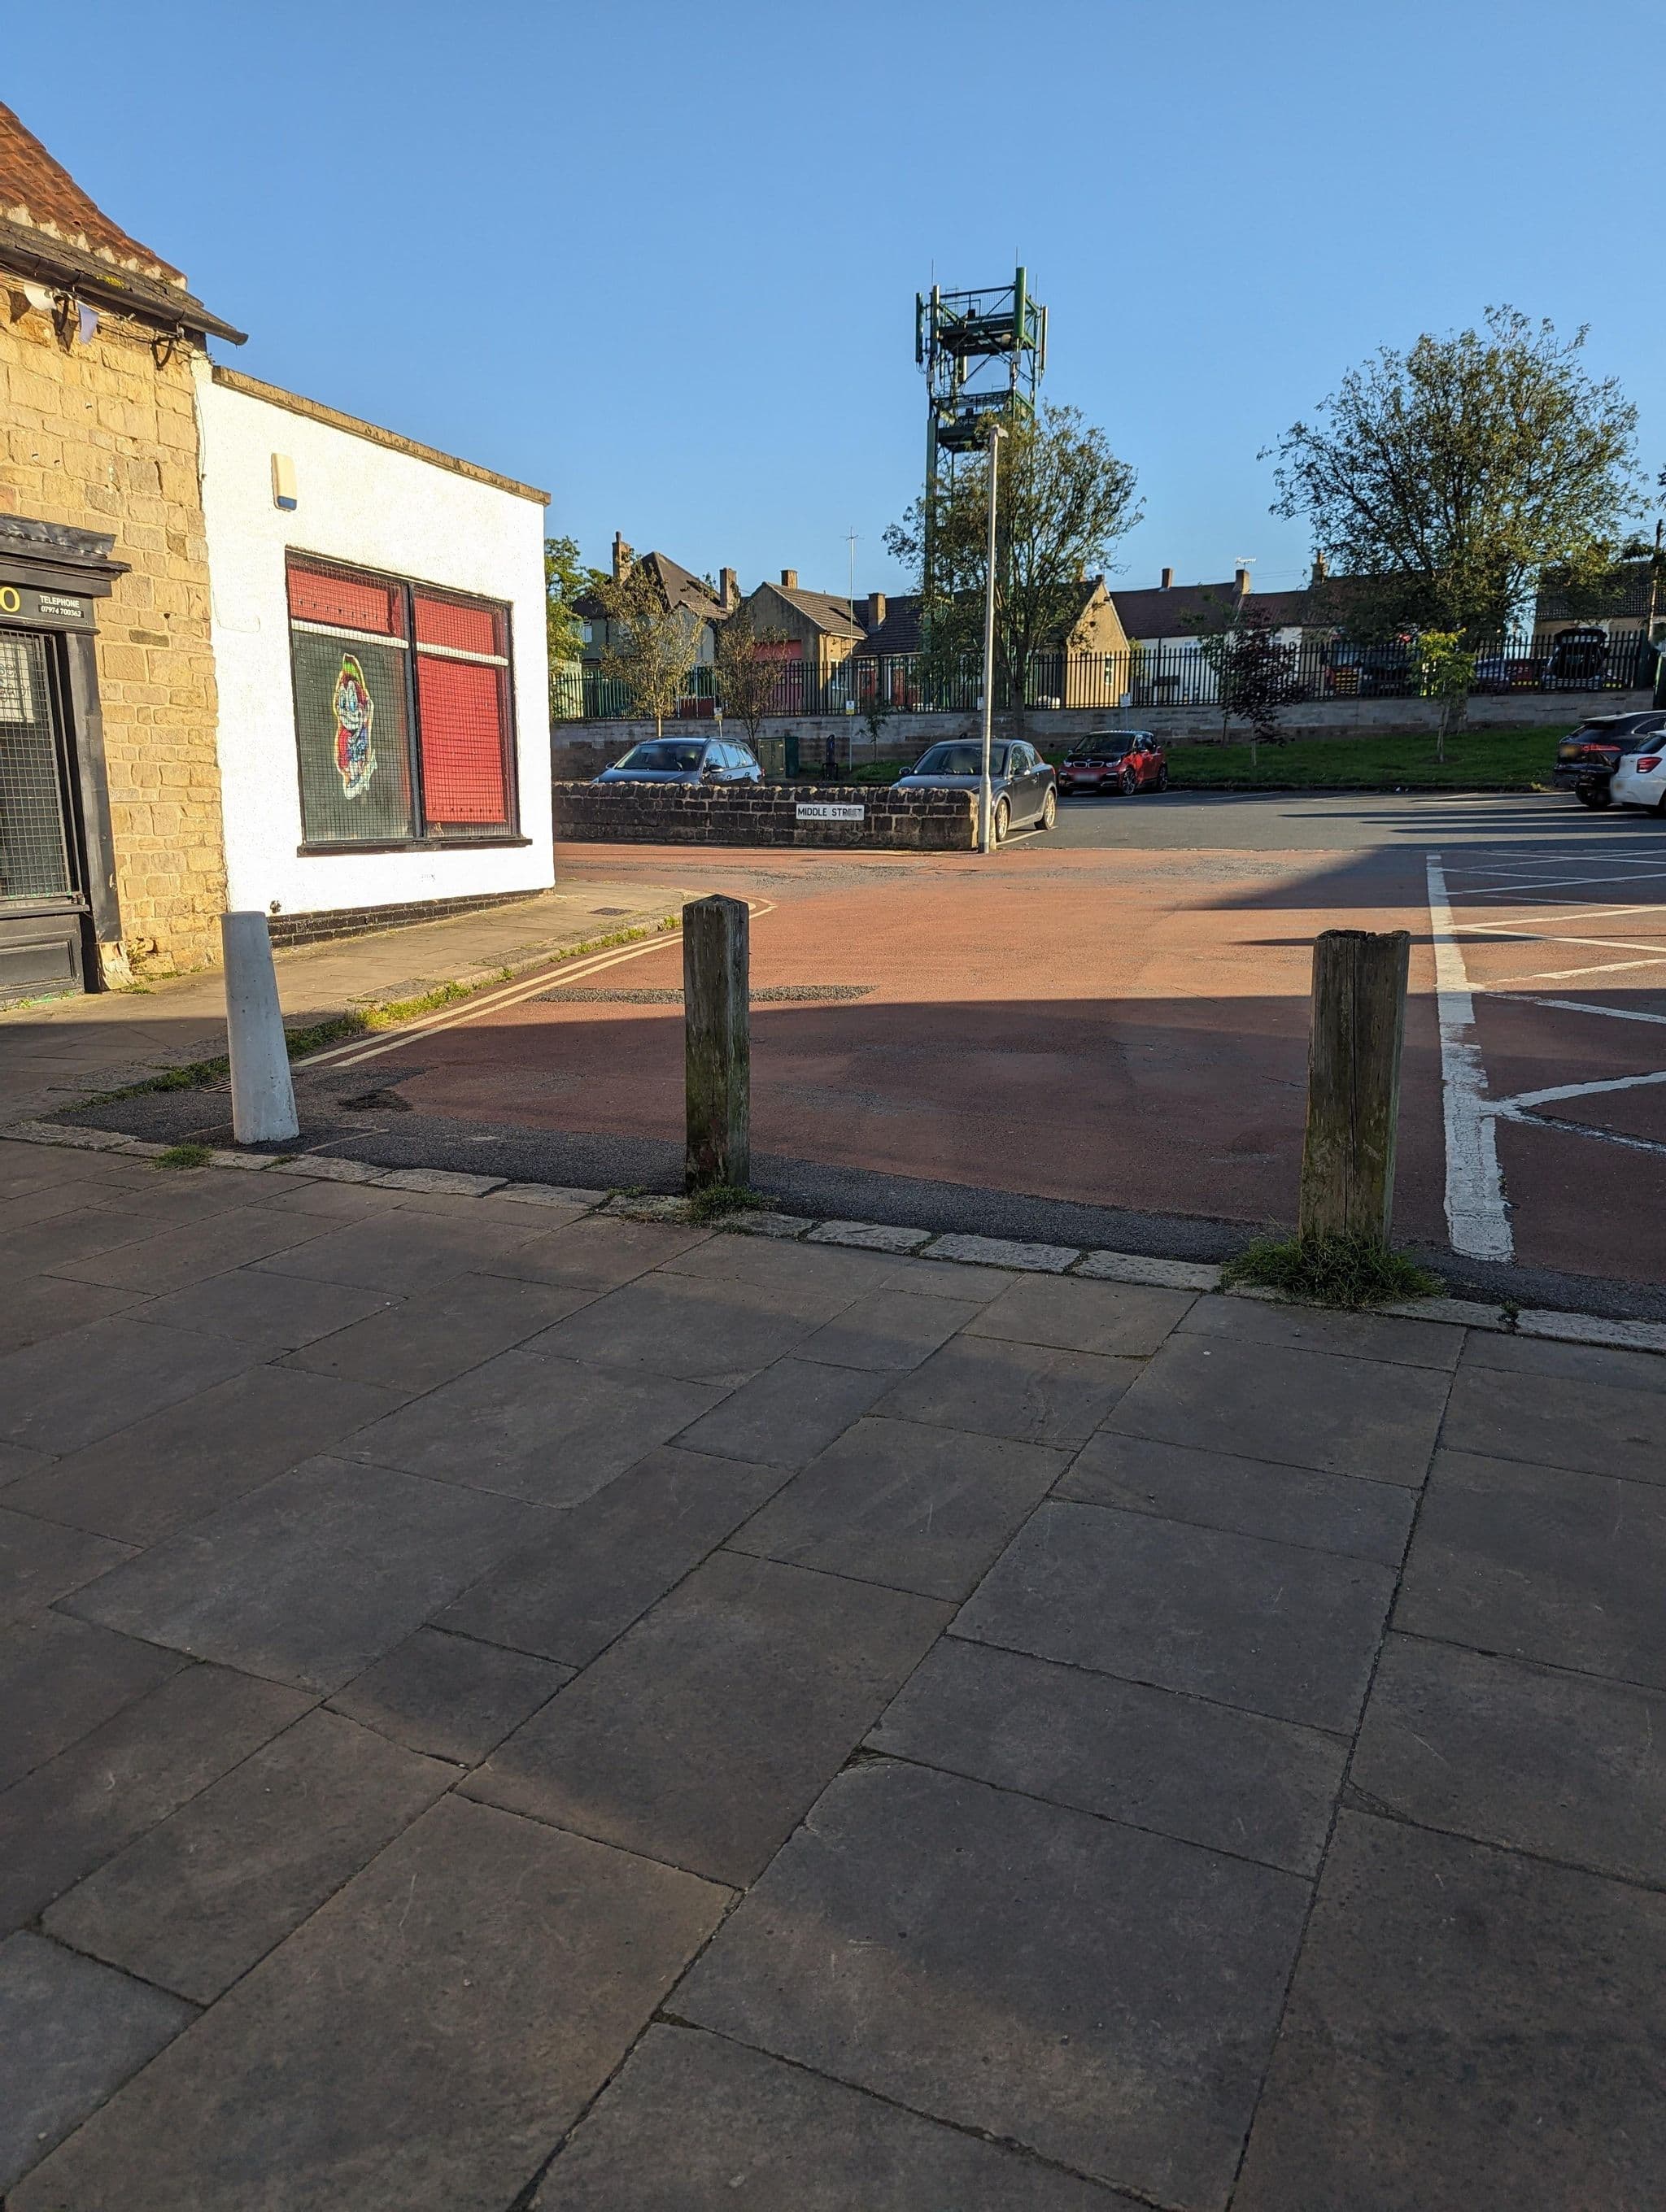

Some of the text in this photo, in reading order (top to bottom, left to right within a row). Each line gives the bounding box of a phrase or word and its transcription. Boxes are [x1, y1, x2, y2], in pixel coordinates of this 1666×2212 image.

[39, 594, 81, 608] TELEPHONE
[41, 605, 59, 615] 07974
[797, 808, 862, 816] MIDDLE STRT
